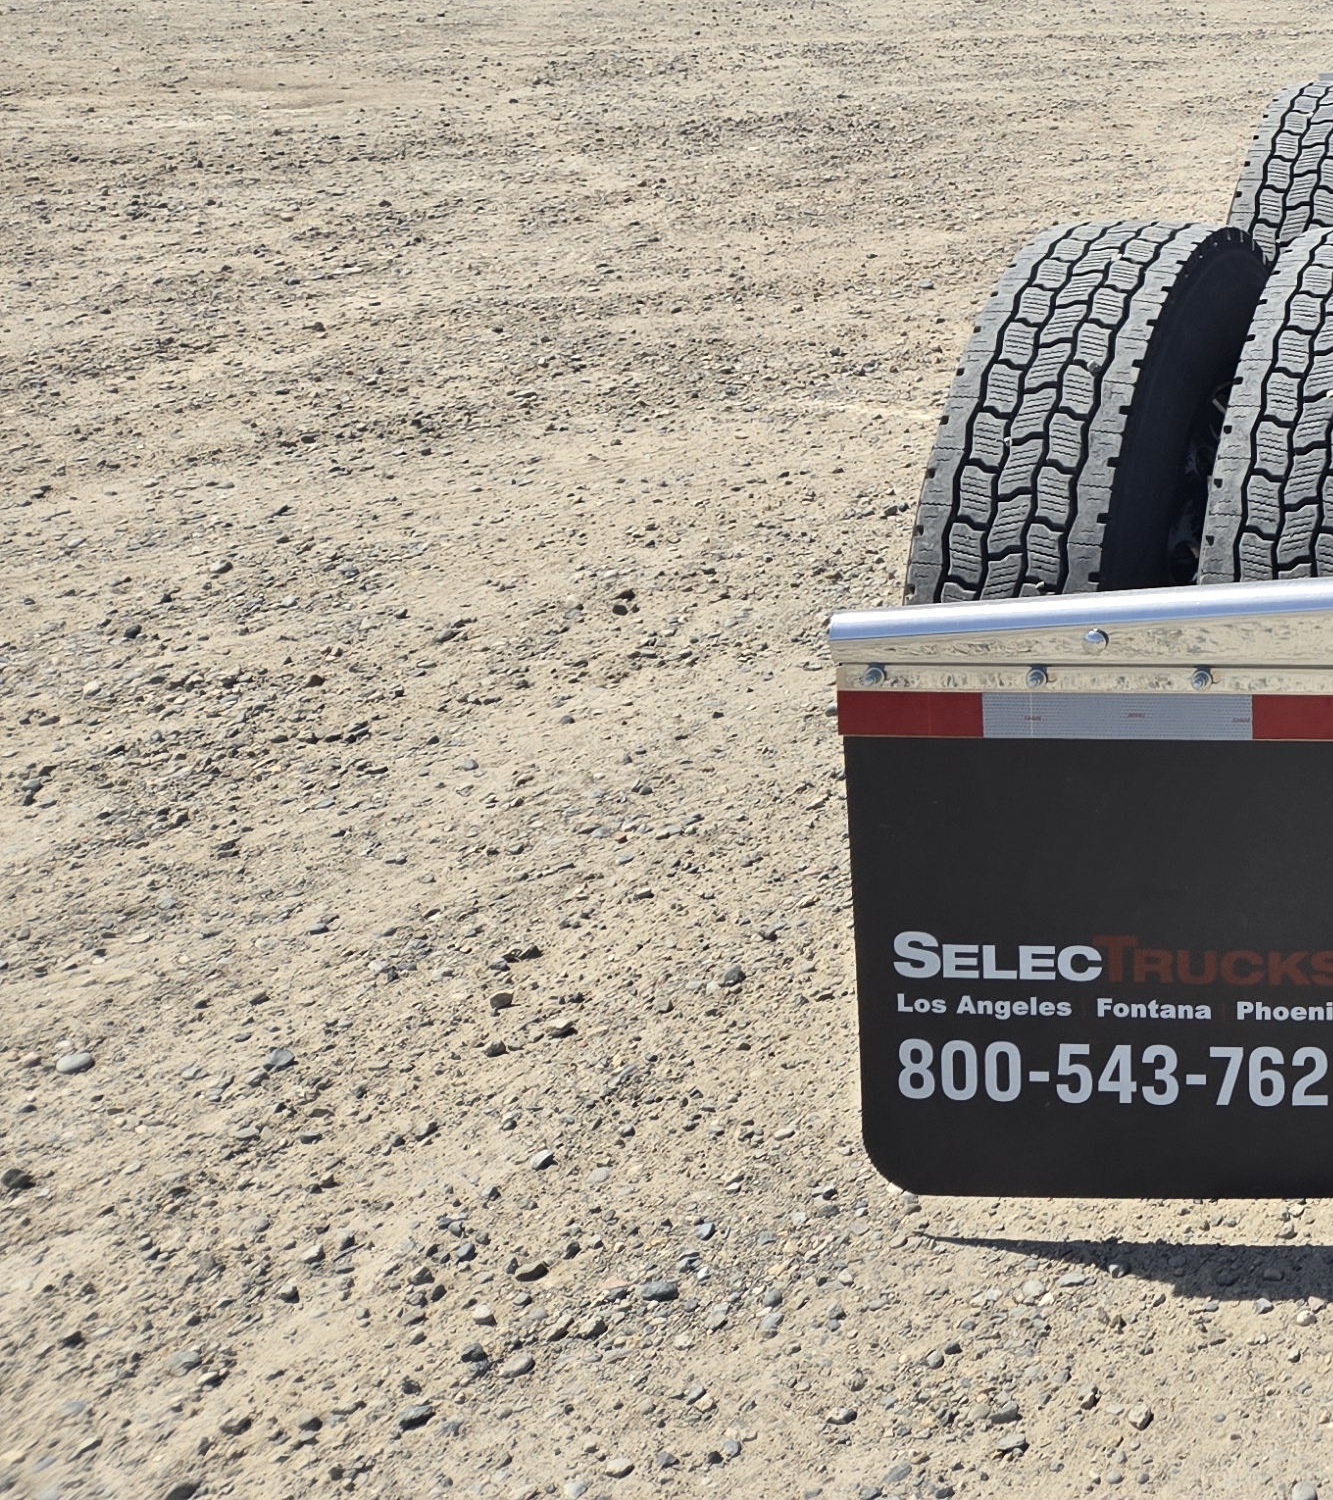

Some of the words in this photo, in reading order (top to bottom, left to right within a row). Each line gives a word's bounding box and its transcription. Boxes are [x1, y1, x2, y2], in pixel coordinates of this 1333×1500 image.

[897, 993, 947, 1014] Los
[956, 995, 1073, 1020] Angeles
[1096, 998, 1212, 1020] Fontana
